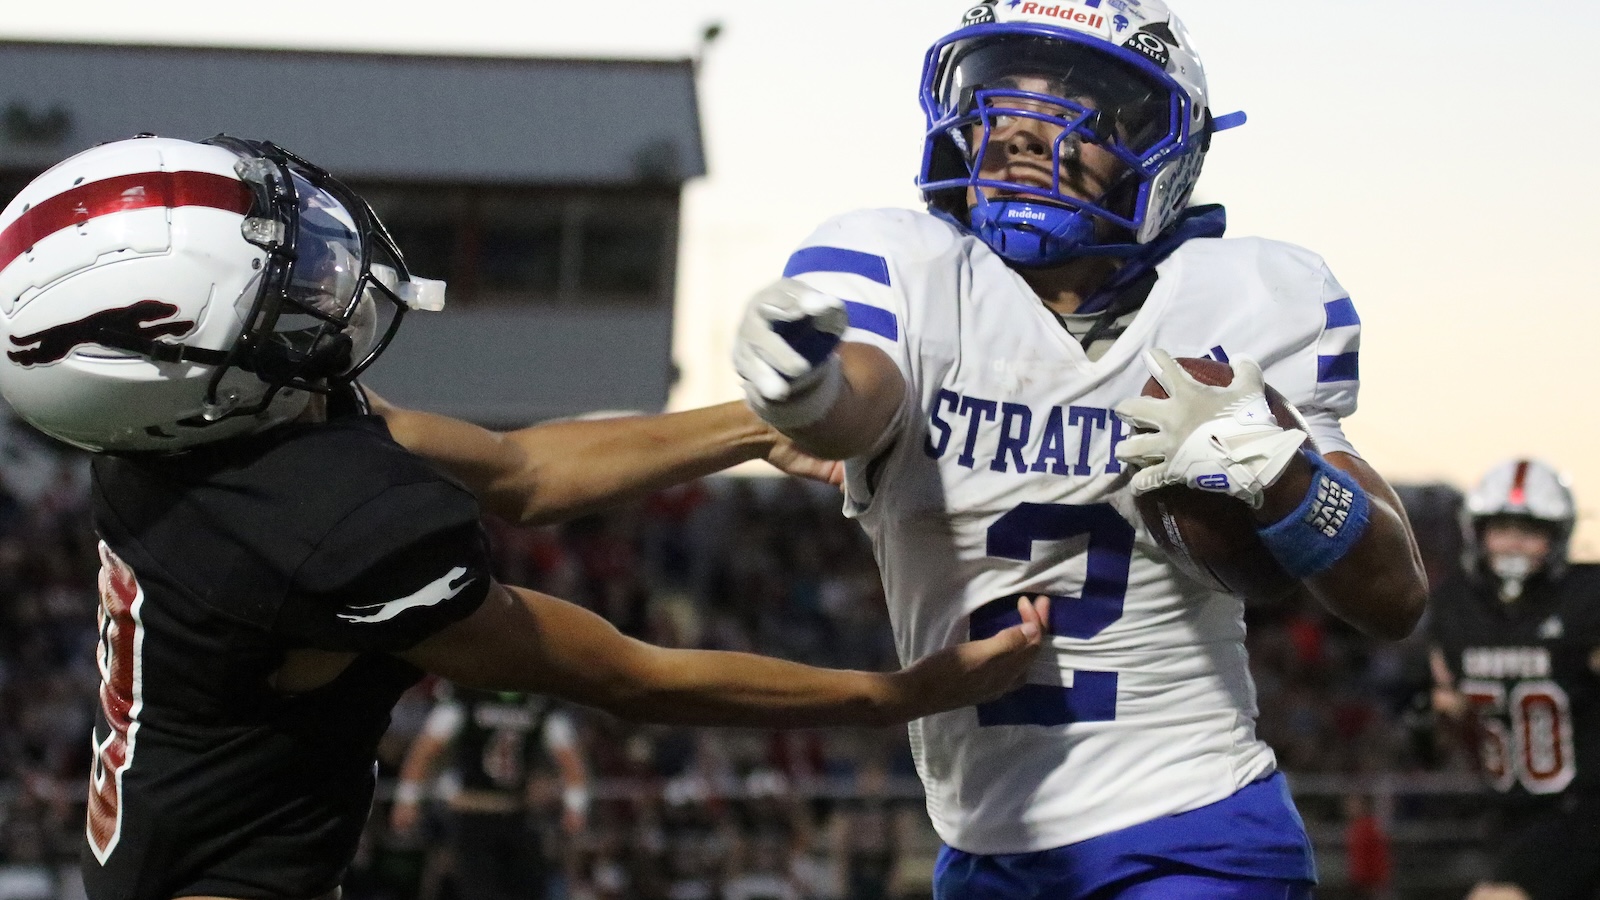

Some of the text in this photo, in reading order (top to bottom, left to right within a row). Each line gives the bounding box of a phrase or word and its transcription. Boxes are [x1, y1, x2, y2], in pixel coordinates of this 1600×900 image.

[1021, 2, 1104, 29] Riddell
[1128, 39, 1167, 64] OAKLEY
[1007, 209, 1046, 221] Riddell
[1312, 480, 1342, 531] GIVE
[1322, 487, 1355, 537] NEVER
[969, 501, 1137, 727] 2
